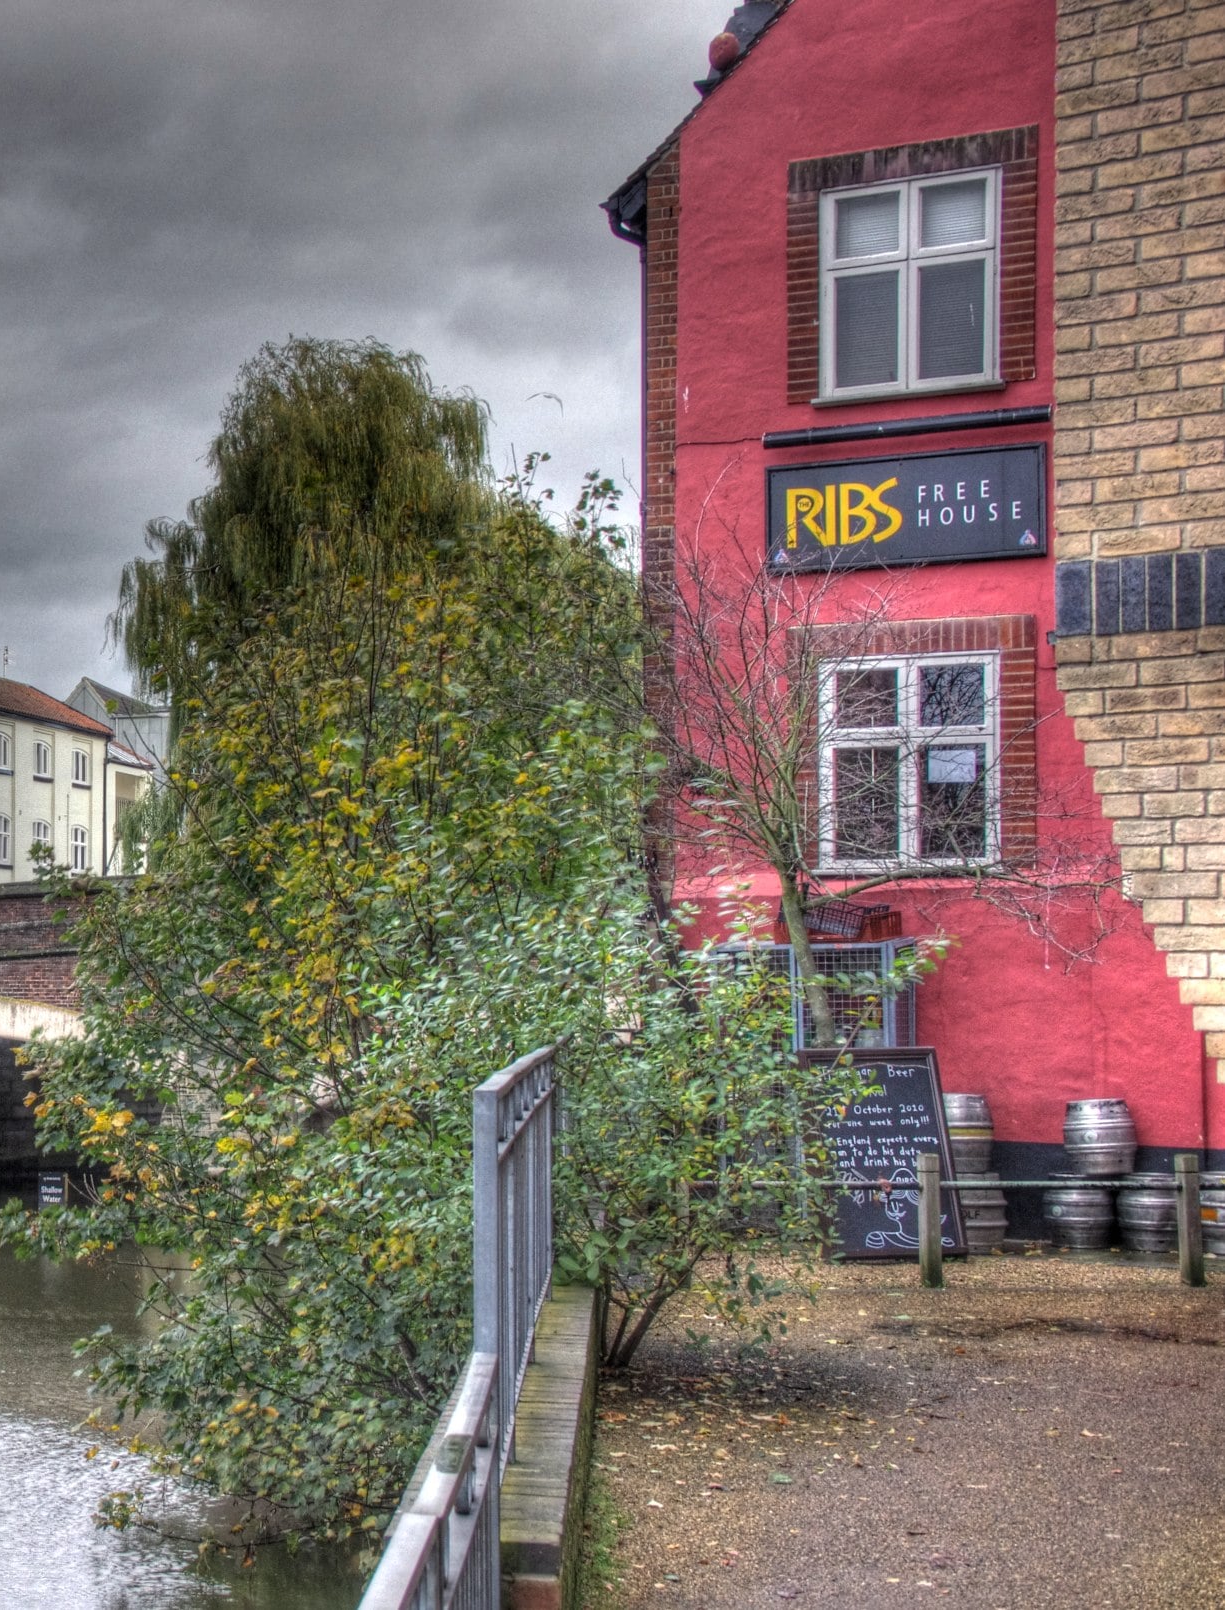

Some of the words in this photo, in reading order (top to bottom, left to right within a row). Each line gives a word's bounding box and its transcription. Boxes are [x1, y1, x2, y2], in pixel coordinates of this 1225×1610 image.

[917, 480, 990, 503] FREE
[786, 477, 903, 549] RIBS
[918, 501, 1022, 527] HOUSE
[887, 1064, 915, 1078] Beer
[853, 1103, 893, 1115] October
[899, 1104, 924, 1113] 2010
[869, 1119, 892, 1127] week
[900, 1115, 930, 1128] only!!!
[877, 1134, 908, 1146] expects
[913, 1135, 940, 1145] every
[853, 1147, 863, 1157] to
[867, 1146, 878, 1156] do
[882, 1145, 894, 1156] his
[839, 1156, 856, 1168] and
[863, 1156, 890, 1168] drink
[893, 1156, 907, 1167] his
